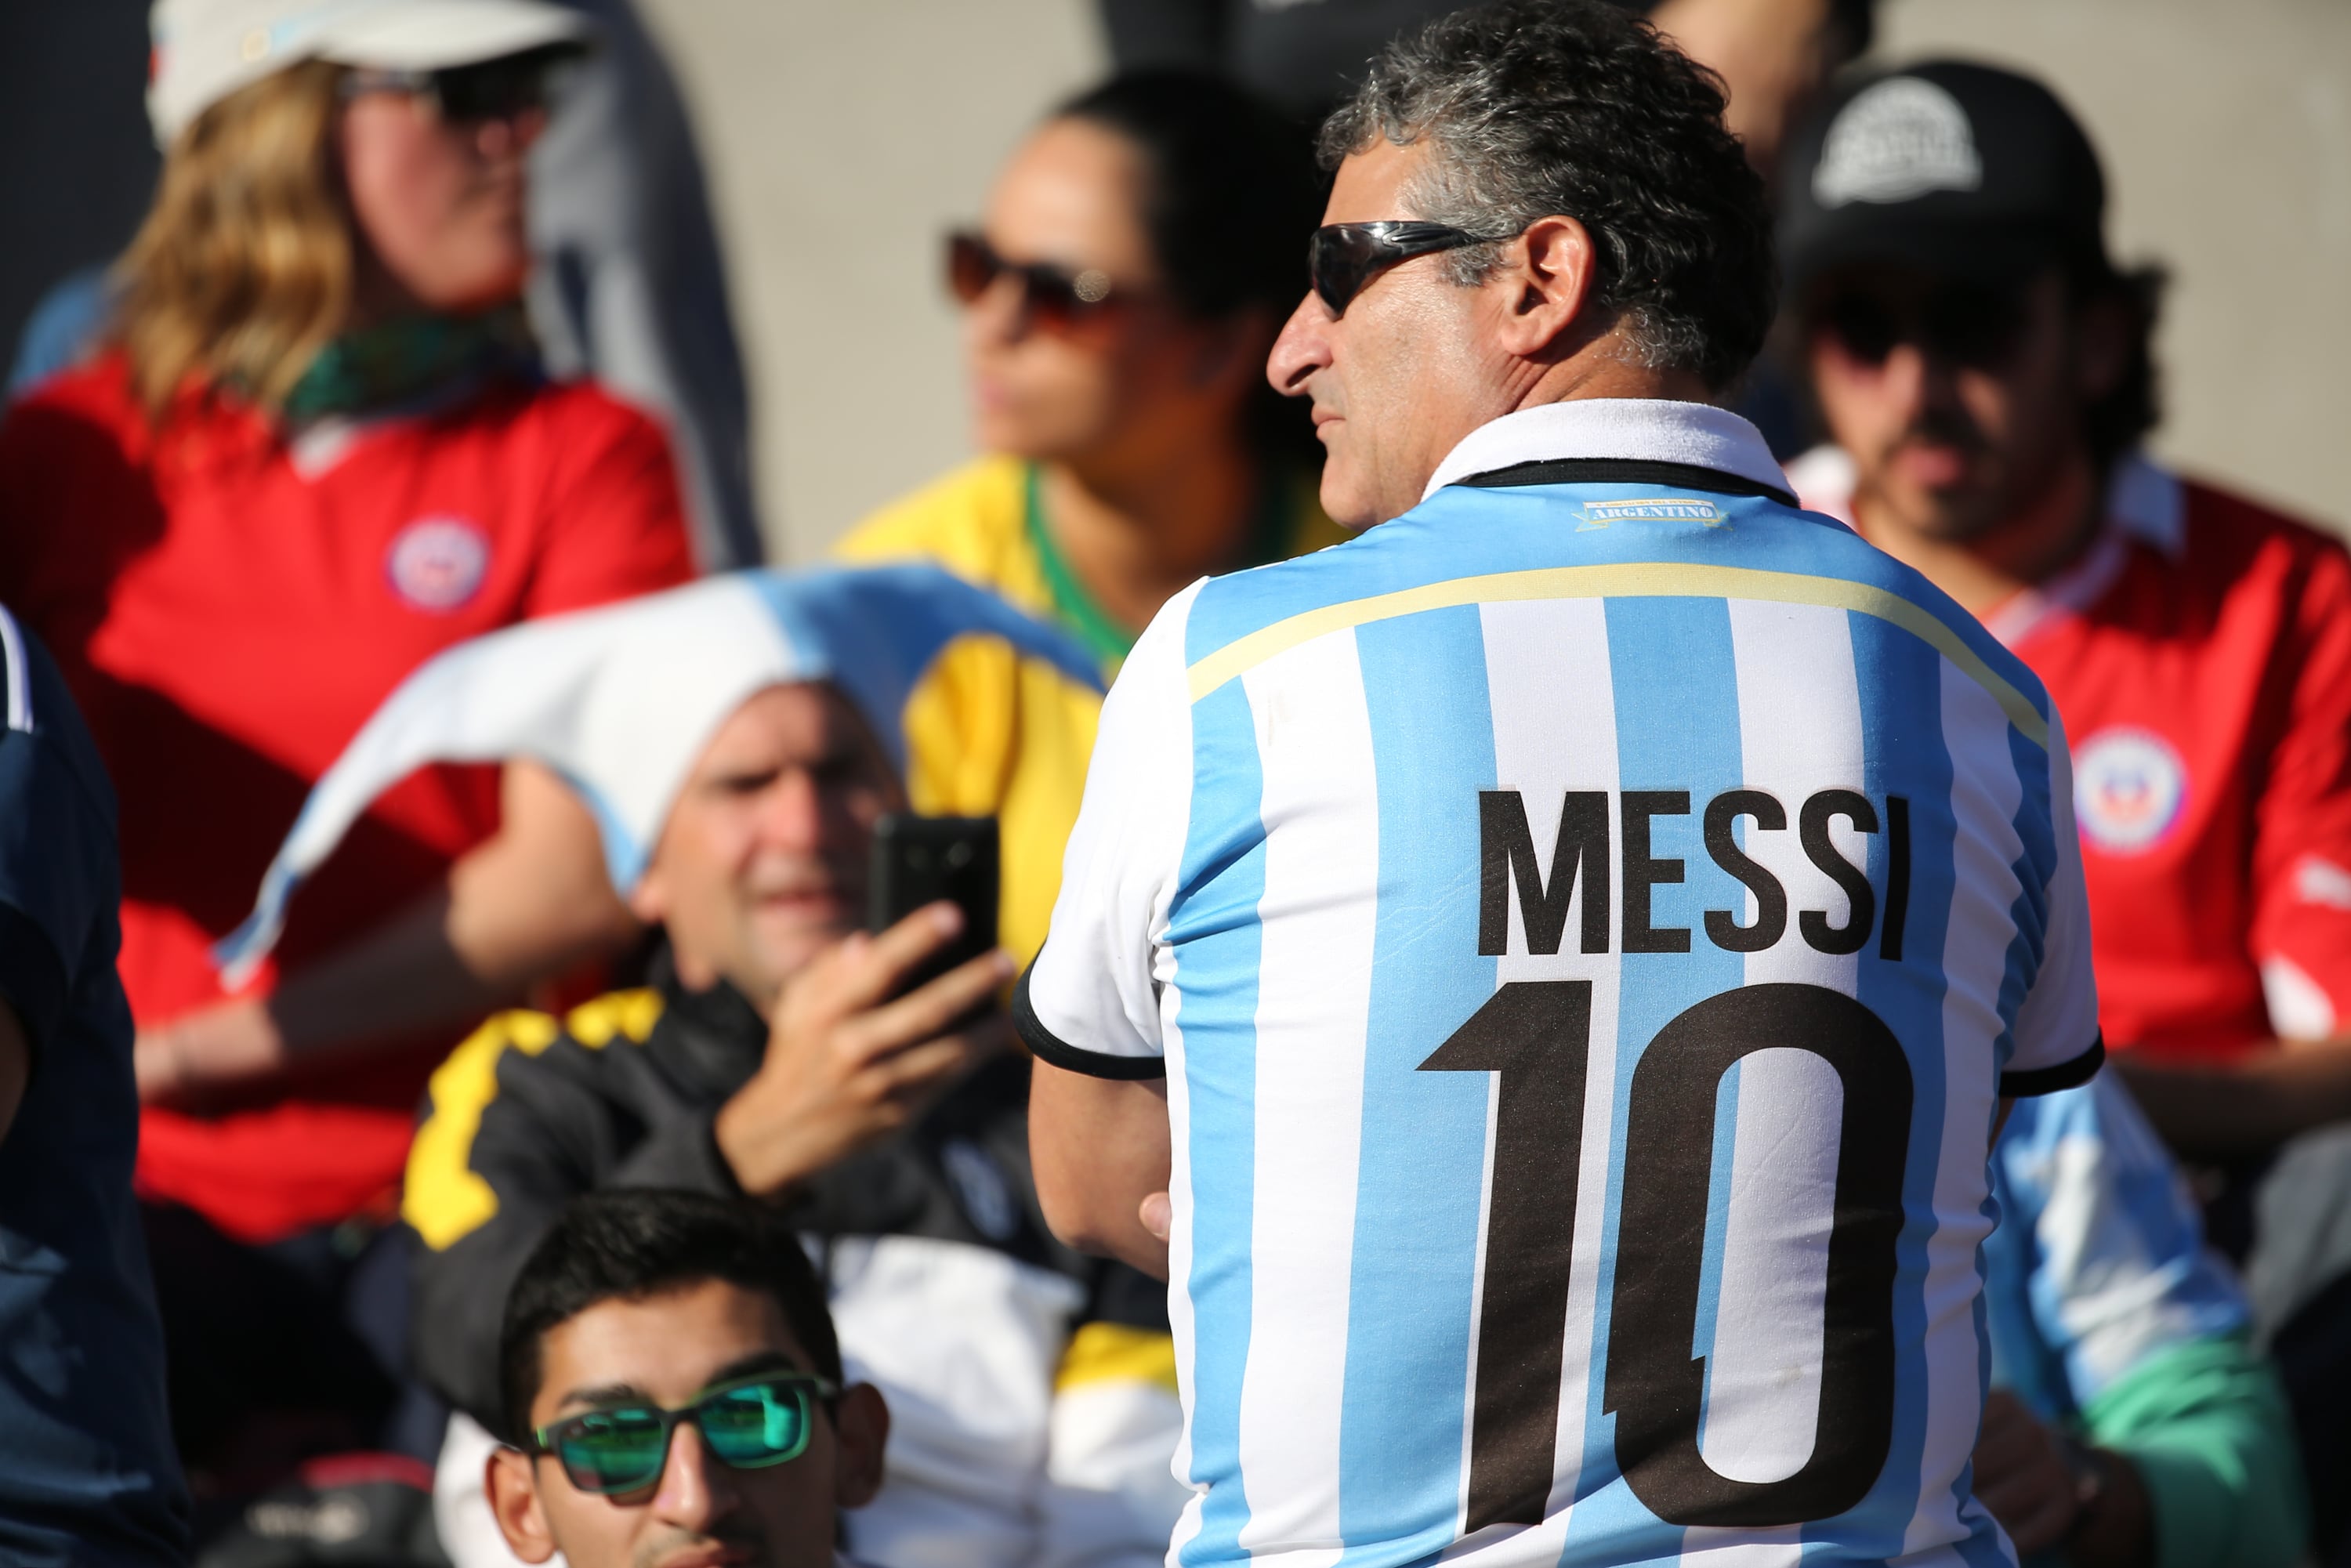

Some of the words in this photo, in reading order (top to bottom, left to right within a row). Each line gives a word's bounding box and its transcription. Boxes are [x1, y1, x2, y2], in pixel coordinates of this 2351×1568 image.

[1593, 506, 1713, 519] ARGENTINO
[1478, 789, 1910, 961] MESSI
[1414, 980, 1914, 1534] 10
